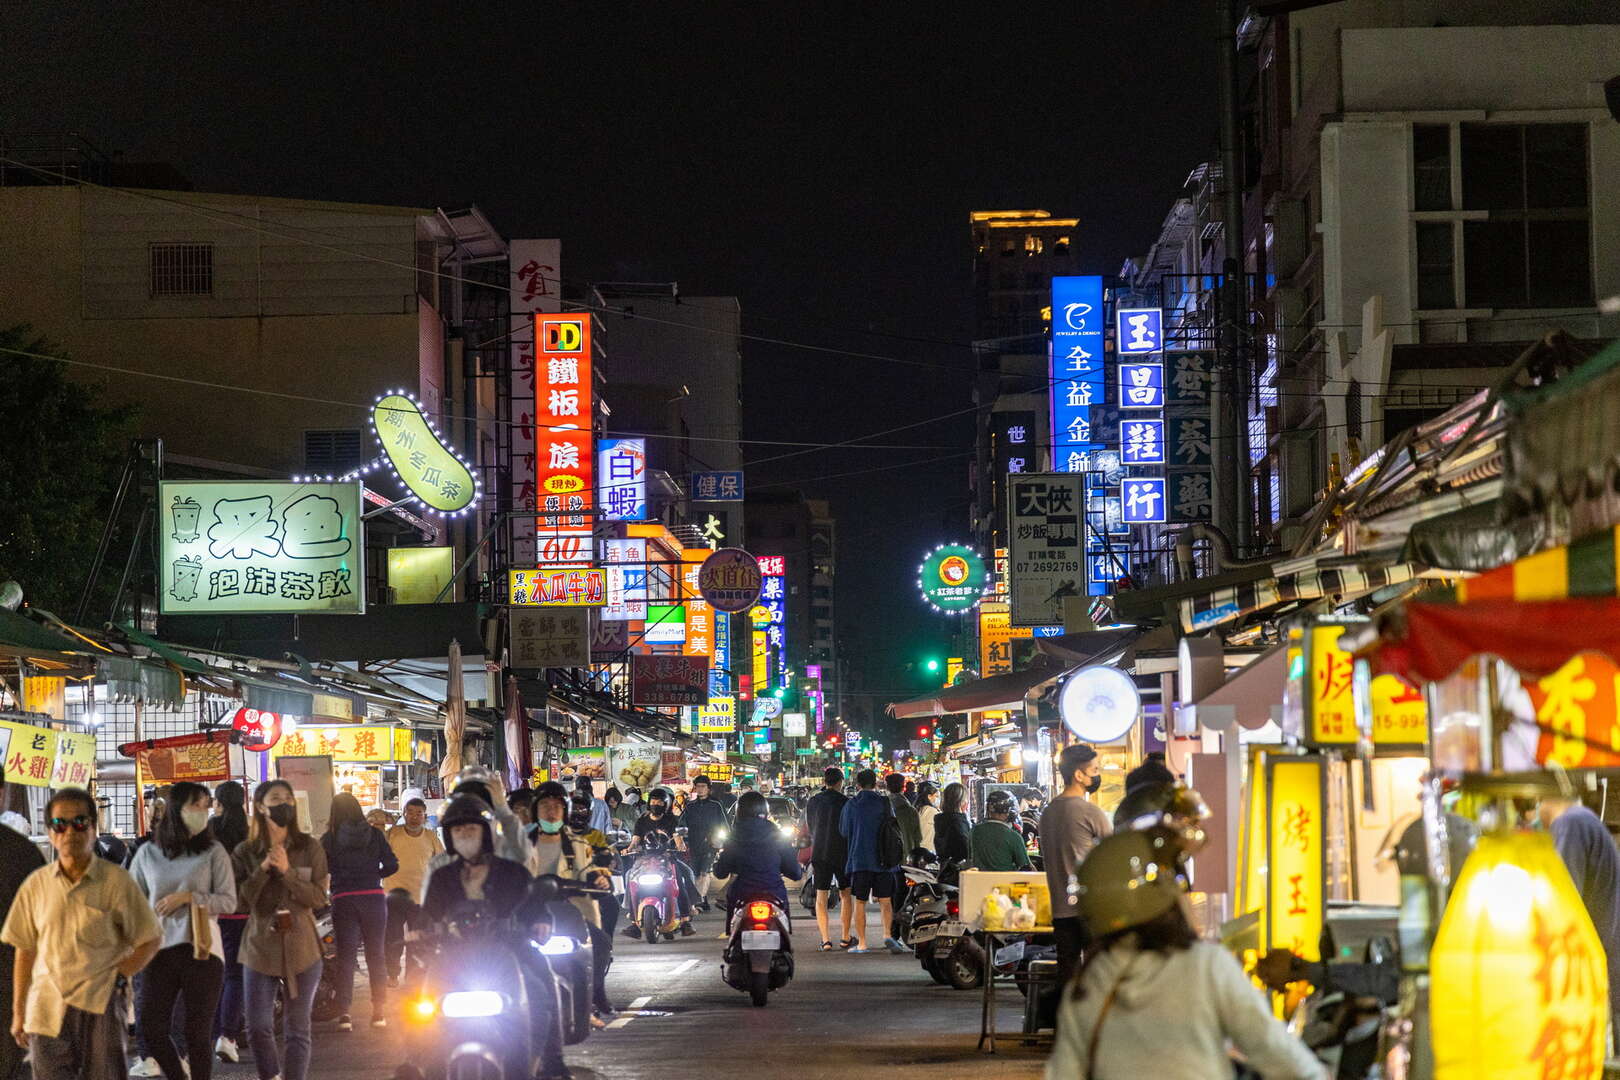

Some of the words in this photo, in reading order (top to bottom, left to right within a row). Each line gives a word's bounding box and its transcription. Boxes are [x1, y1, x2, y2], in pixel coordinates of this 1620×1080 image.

[547, 357, 579, 469] 鐵板一族
[1126, 313, 1162, 519] 玉昌鞋行
[608, 451, 637, 516] 白蝦
[696, 474, 739, 497] 健保
[1020, 485, 1072, 513] 大俠
[208, 566, 352, 600] 泡沫茶飲
[1016, 562, 1029, 573] 07
[1033, 561, 1079, 573] 2692769
[531, 571, 605, 604] 木瓜牛奶
[7, 751, 88, 784] 火雞肉飯
